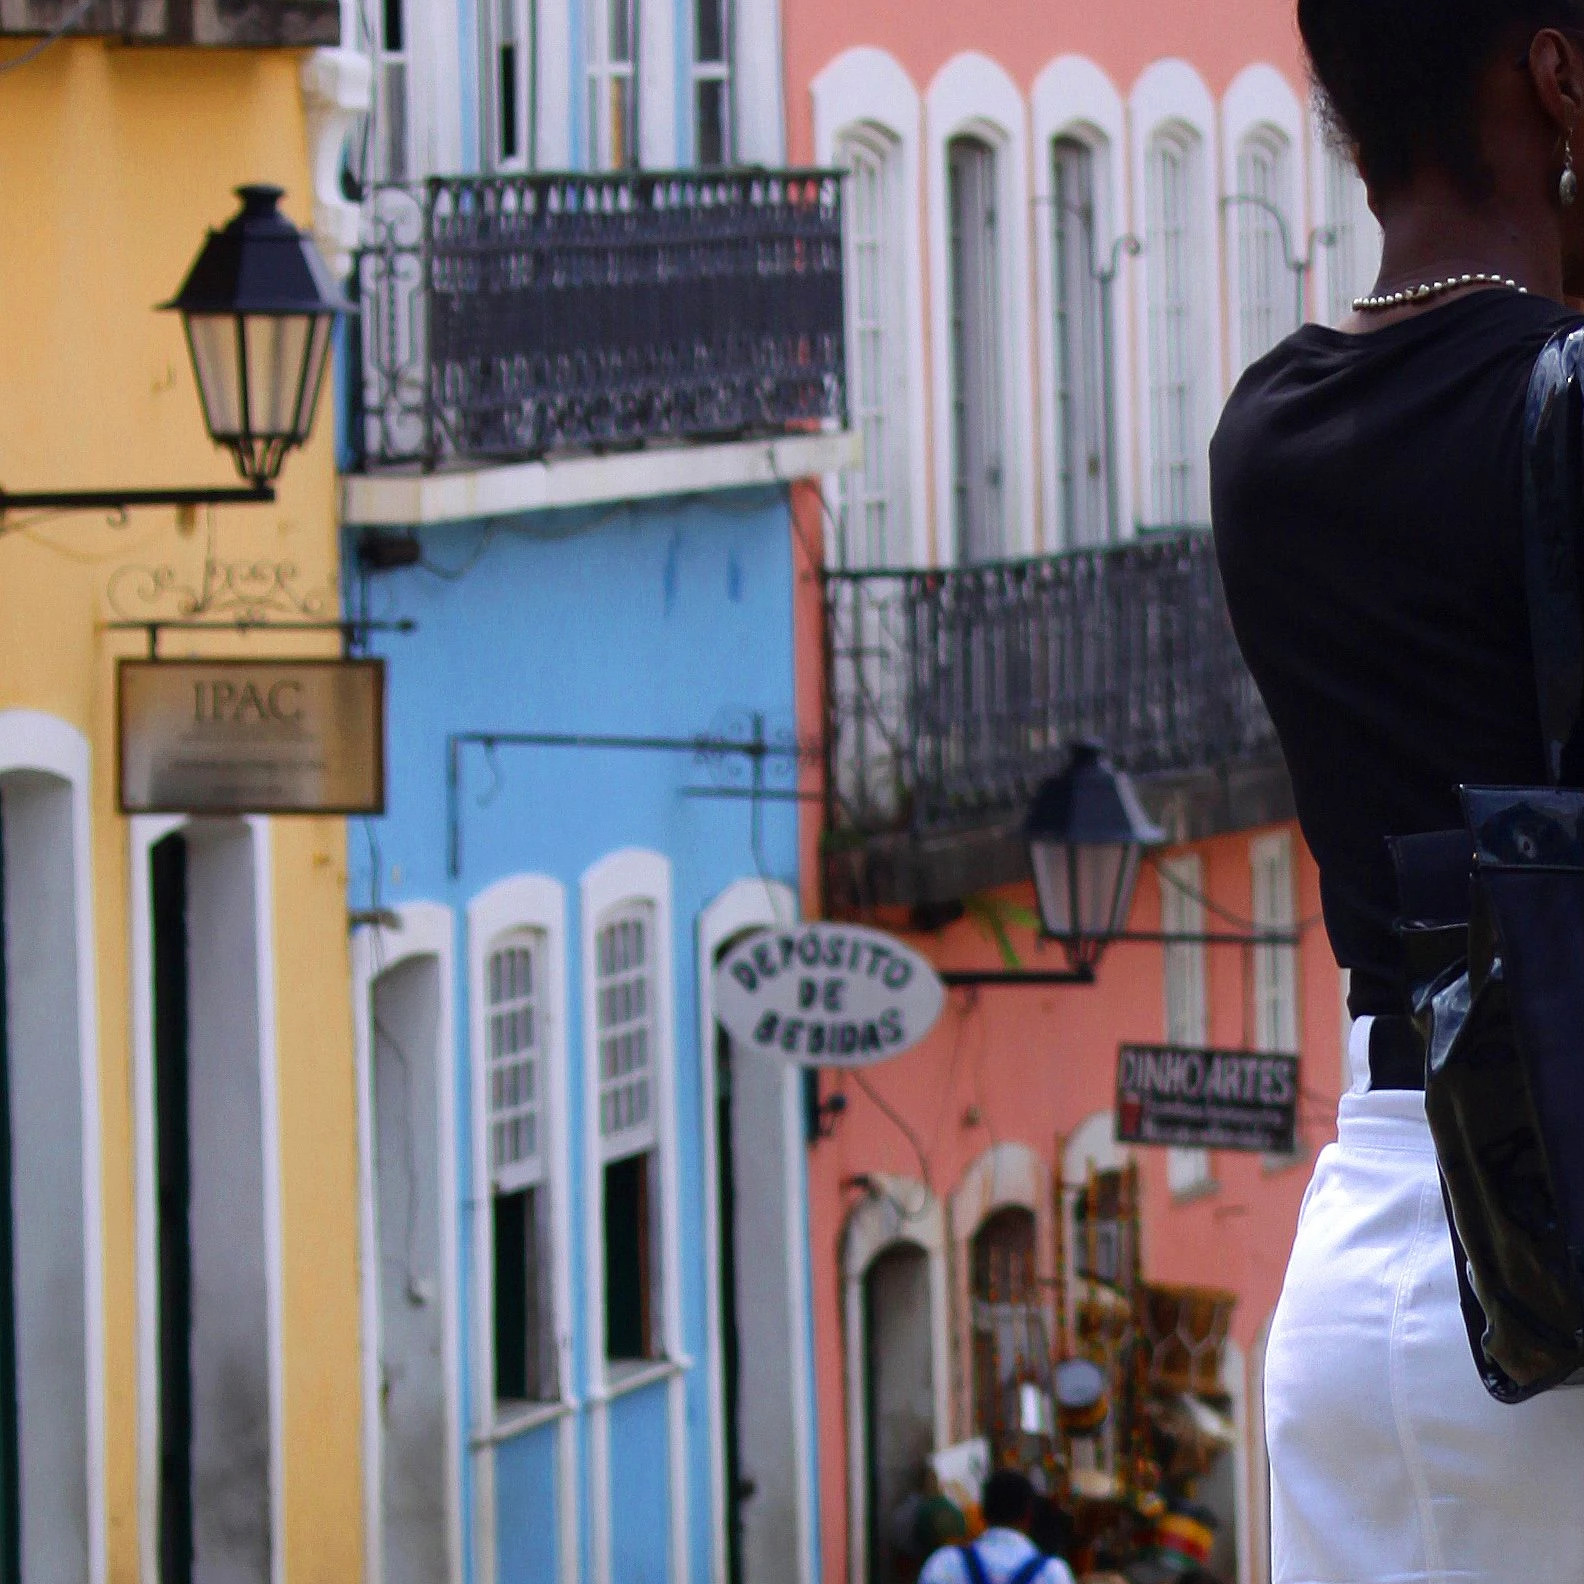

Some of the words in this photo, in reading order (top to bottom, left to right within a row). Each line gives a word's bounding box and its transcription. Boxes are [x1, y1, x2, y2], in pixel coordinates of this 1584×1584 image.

[192, 679, 305, 722] IPAC
[799, 979, 844, 1012] DE
[754, 1009, 903, 1054] BEBIDAS
[1122, 1050, 1203, 1096] DINHO
[1206, 1054, 1292, 1103] ARTES
